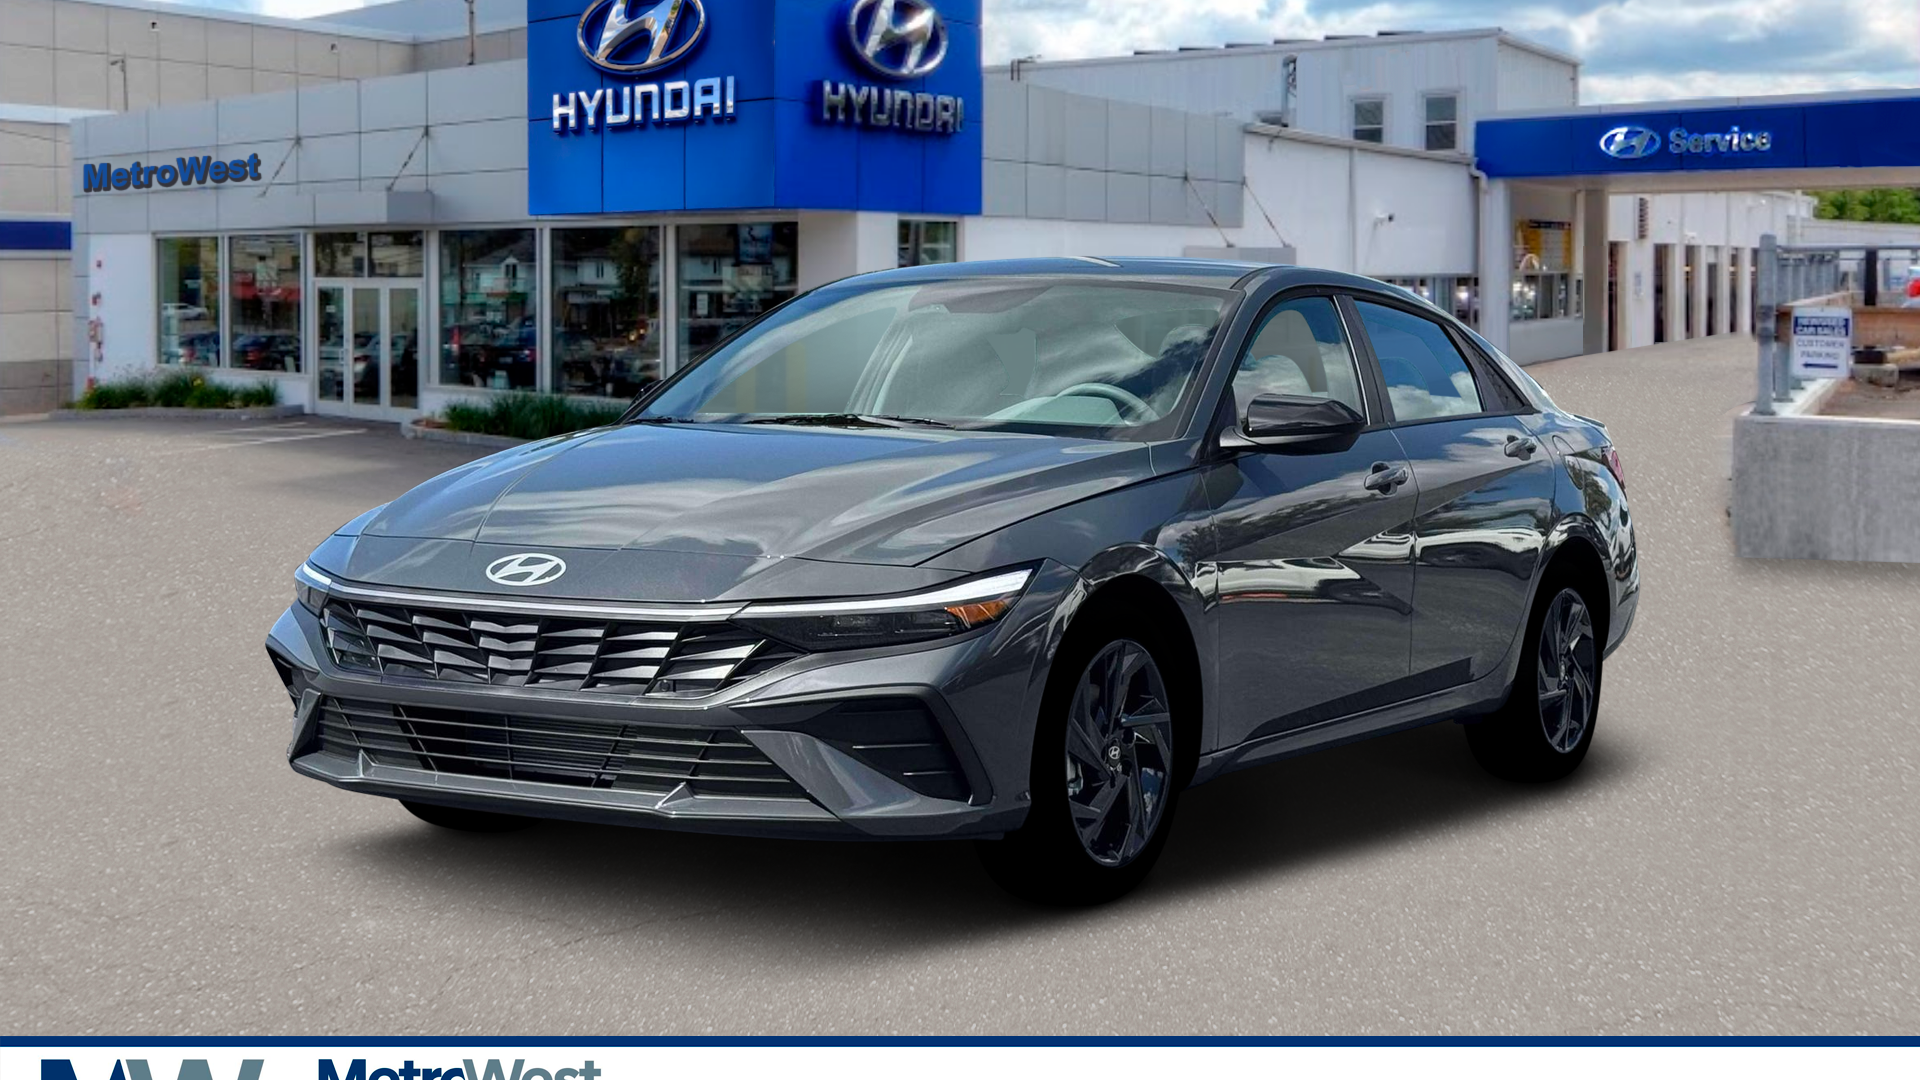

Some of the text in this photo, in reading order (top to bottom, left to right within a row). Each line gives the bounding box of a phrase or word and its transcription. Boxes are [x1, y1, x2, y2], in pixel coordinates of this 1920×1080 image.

[552, 76, 736, 134] HYUNDAI
[822, 79, 964, 133] HYUNDAI
[1668, 126, 1772, 153] Service
[83, 153, 262, 193] MetroWest
[1796, 339, 1845, 348] CUSTOMER
[1800, 350, 1840, 360] PARKING
